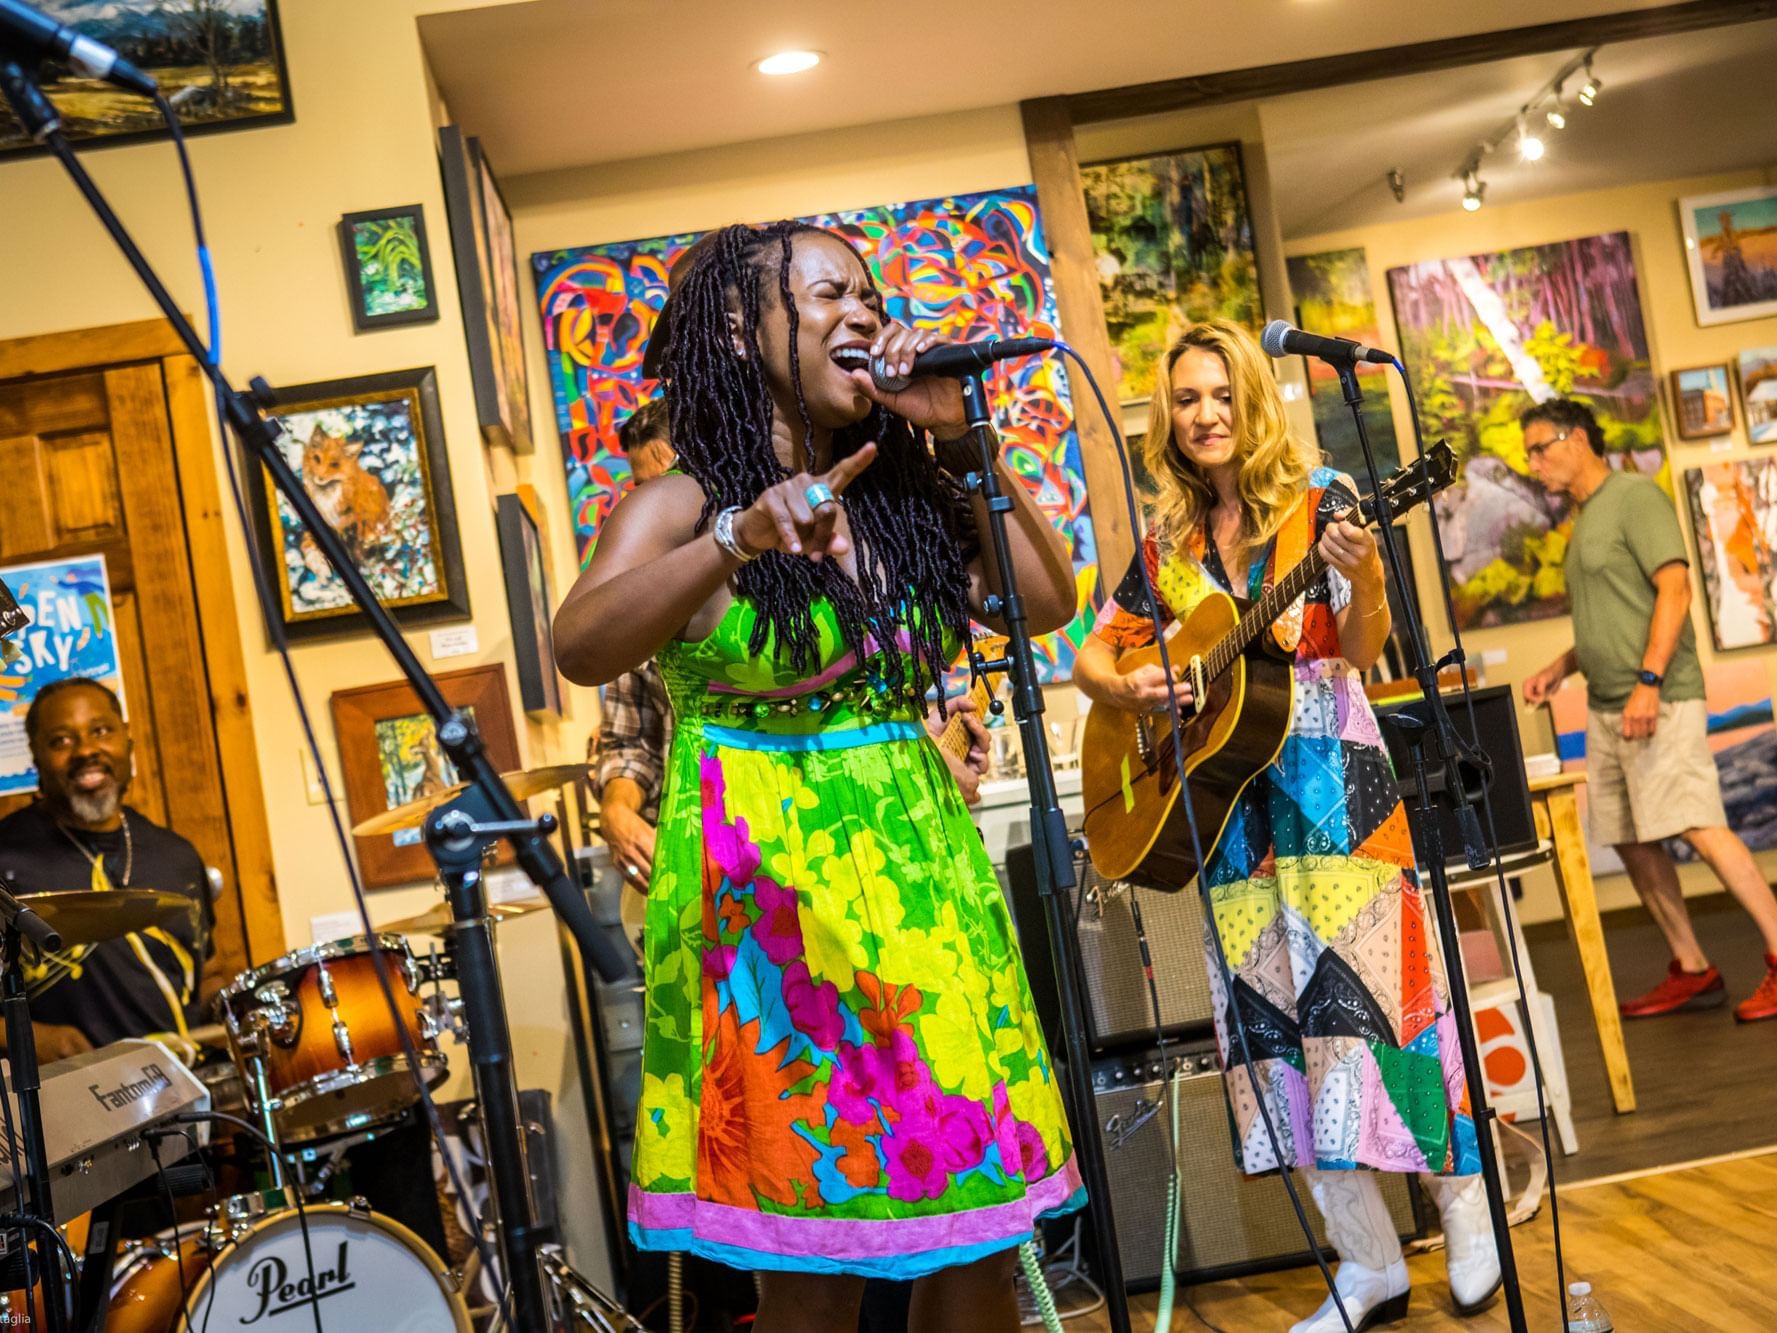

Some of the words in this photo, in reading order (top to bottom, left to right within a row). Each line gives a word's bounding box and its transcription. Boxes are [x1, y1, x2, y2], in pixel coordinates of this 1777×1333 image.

[17, 591, 82, 640] PEN
[10, 630, 73, 674] SKY
[239, 1240, 351, 1325] Pearl
